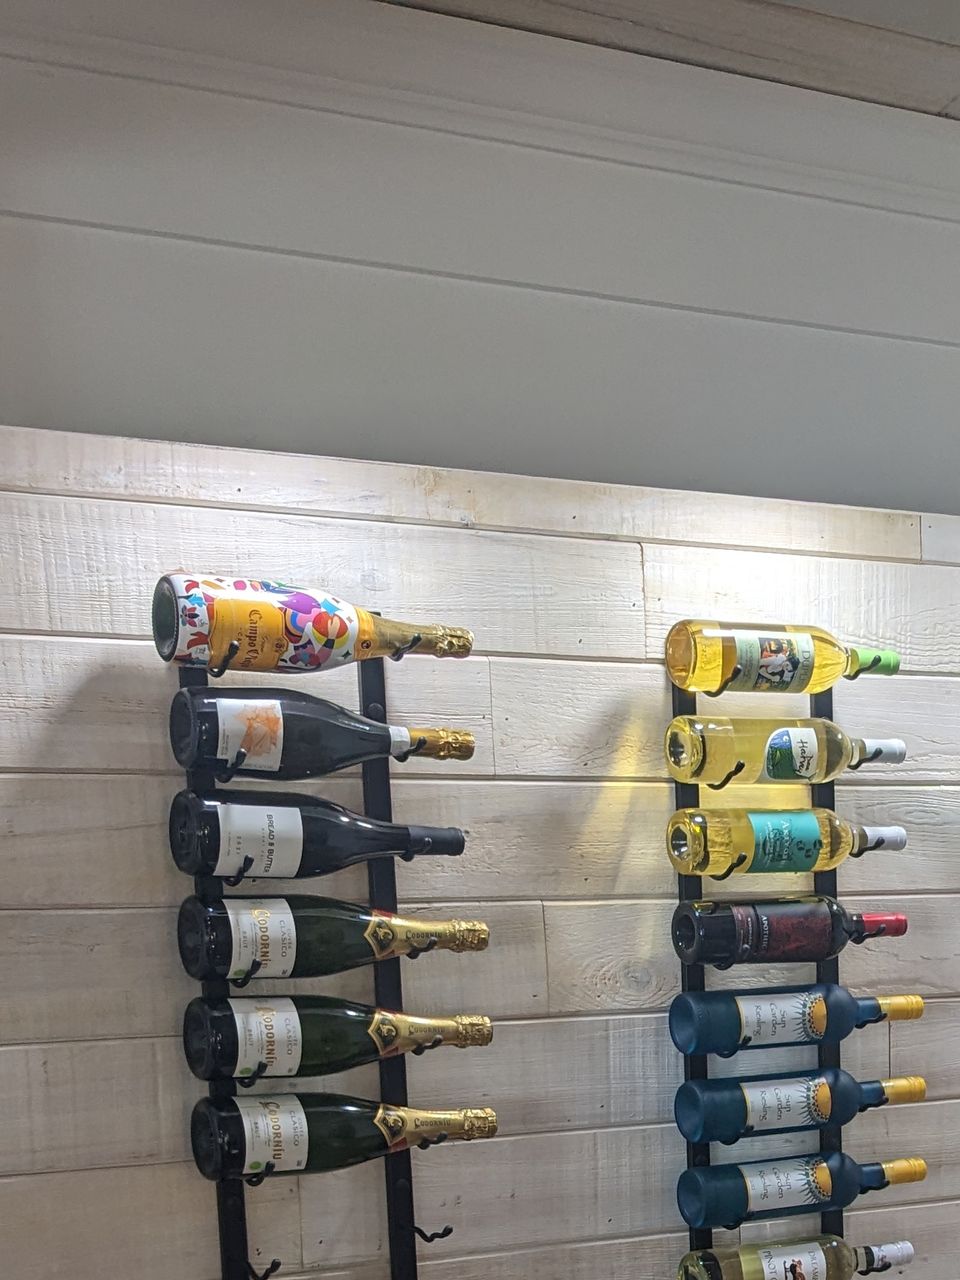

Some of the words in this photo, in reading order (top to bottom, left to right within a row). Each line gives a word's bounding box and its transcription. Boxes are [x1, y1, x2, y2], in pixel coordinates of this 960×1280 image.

[245, 610, 262, 647] Campo
[795, 739, 807, 773] Harvey
[266, 814, 275, 839] BREAD
[263, 849, 274, 873] BUTTER
[769, 1003, 780, 1036] Garden
[776, 1010, 788, 1028] Sun
[774, 1088, 784, 1120] Garden
[781, 1094, 792, 1113] Sun
[772, 1168, 785, 1199] Garden
[782, 1172, 792, 1190] Sun
[763, 1251, 777, 1274] PINOT
